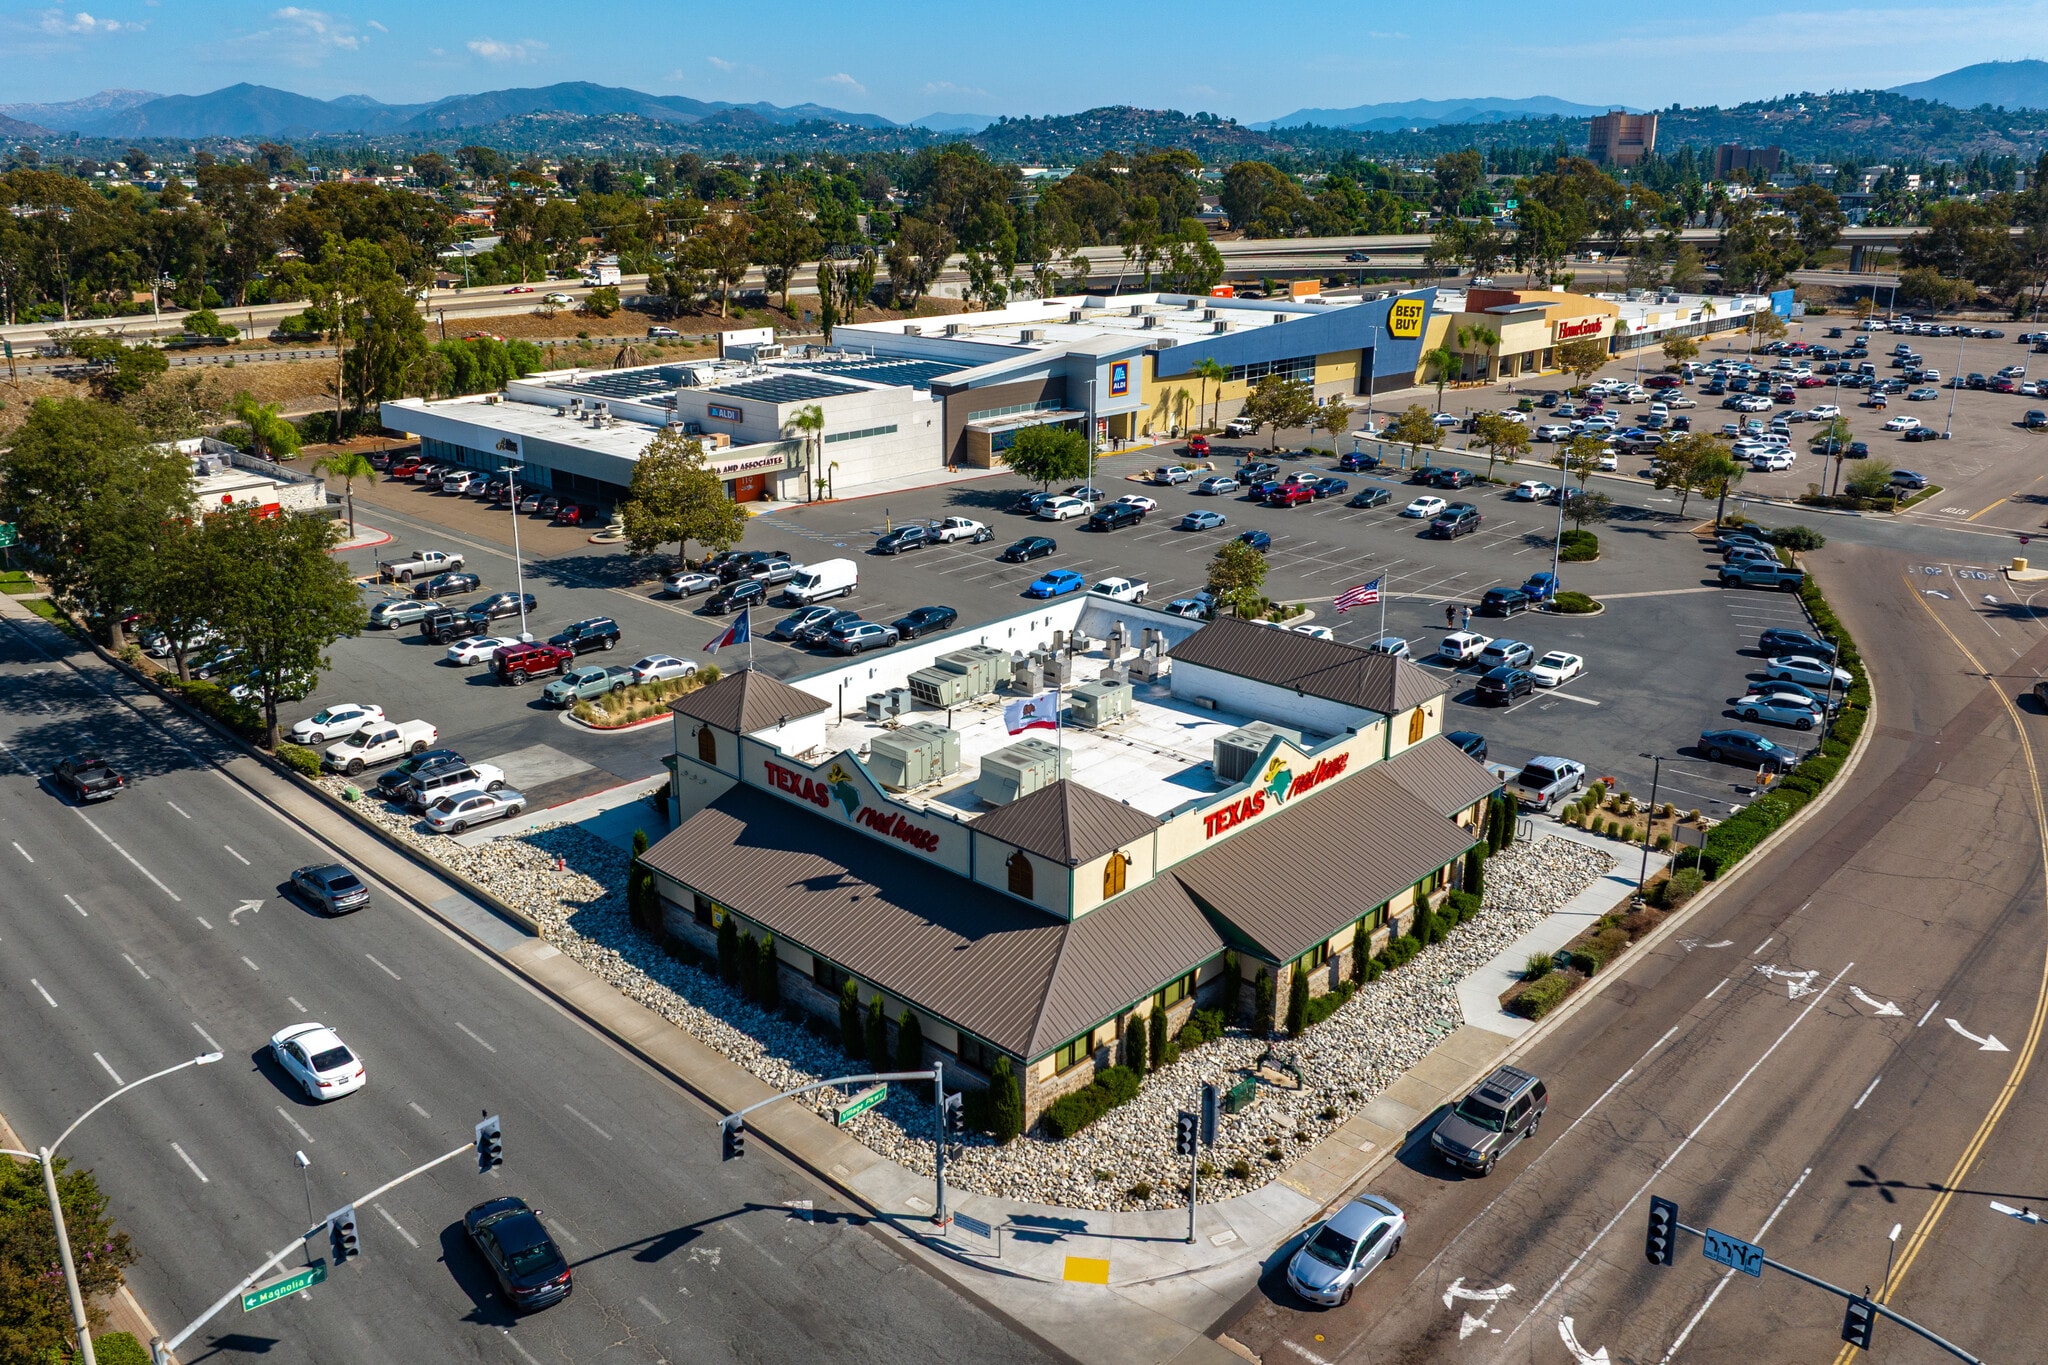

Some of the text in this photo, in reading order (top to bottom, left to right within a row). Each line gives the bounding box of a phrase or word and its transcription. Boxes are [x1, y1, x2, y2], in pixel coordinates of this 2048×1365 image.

[1395, 305, 1422, 318] BEST
[1395, 318, 1418, 330] BUY
[1558, 317, 1602, 339] HomeGoods
[1113, 381, 1126, 390] ALDI
[718, 408, 735, 420] ALDI
[723, 464, 739, 473] AND
[740, 456, 783, 471] ASSOCIATES
[1940, 506, 1969, 515] STOP
[1959, 570, 1996, 580] STOP
[764, 760, 829, 808] TEXAS
[1203, 790, 1266, 840] TEXAS
[842, 1103, 864, 1119] Village
[260, 1279, 304, 1302] Magnolia
